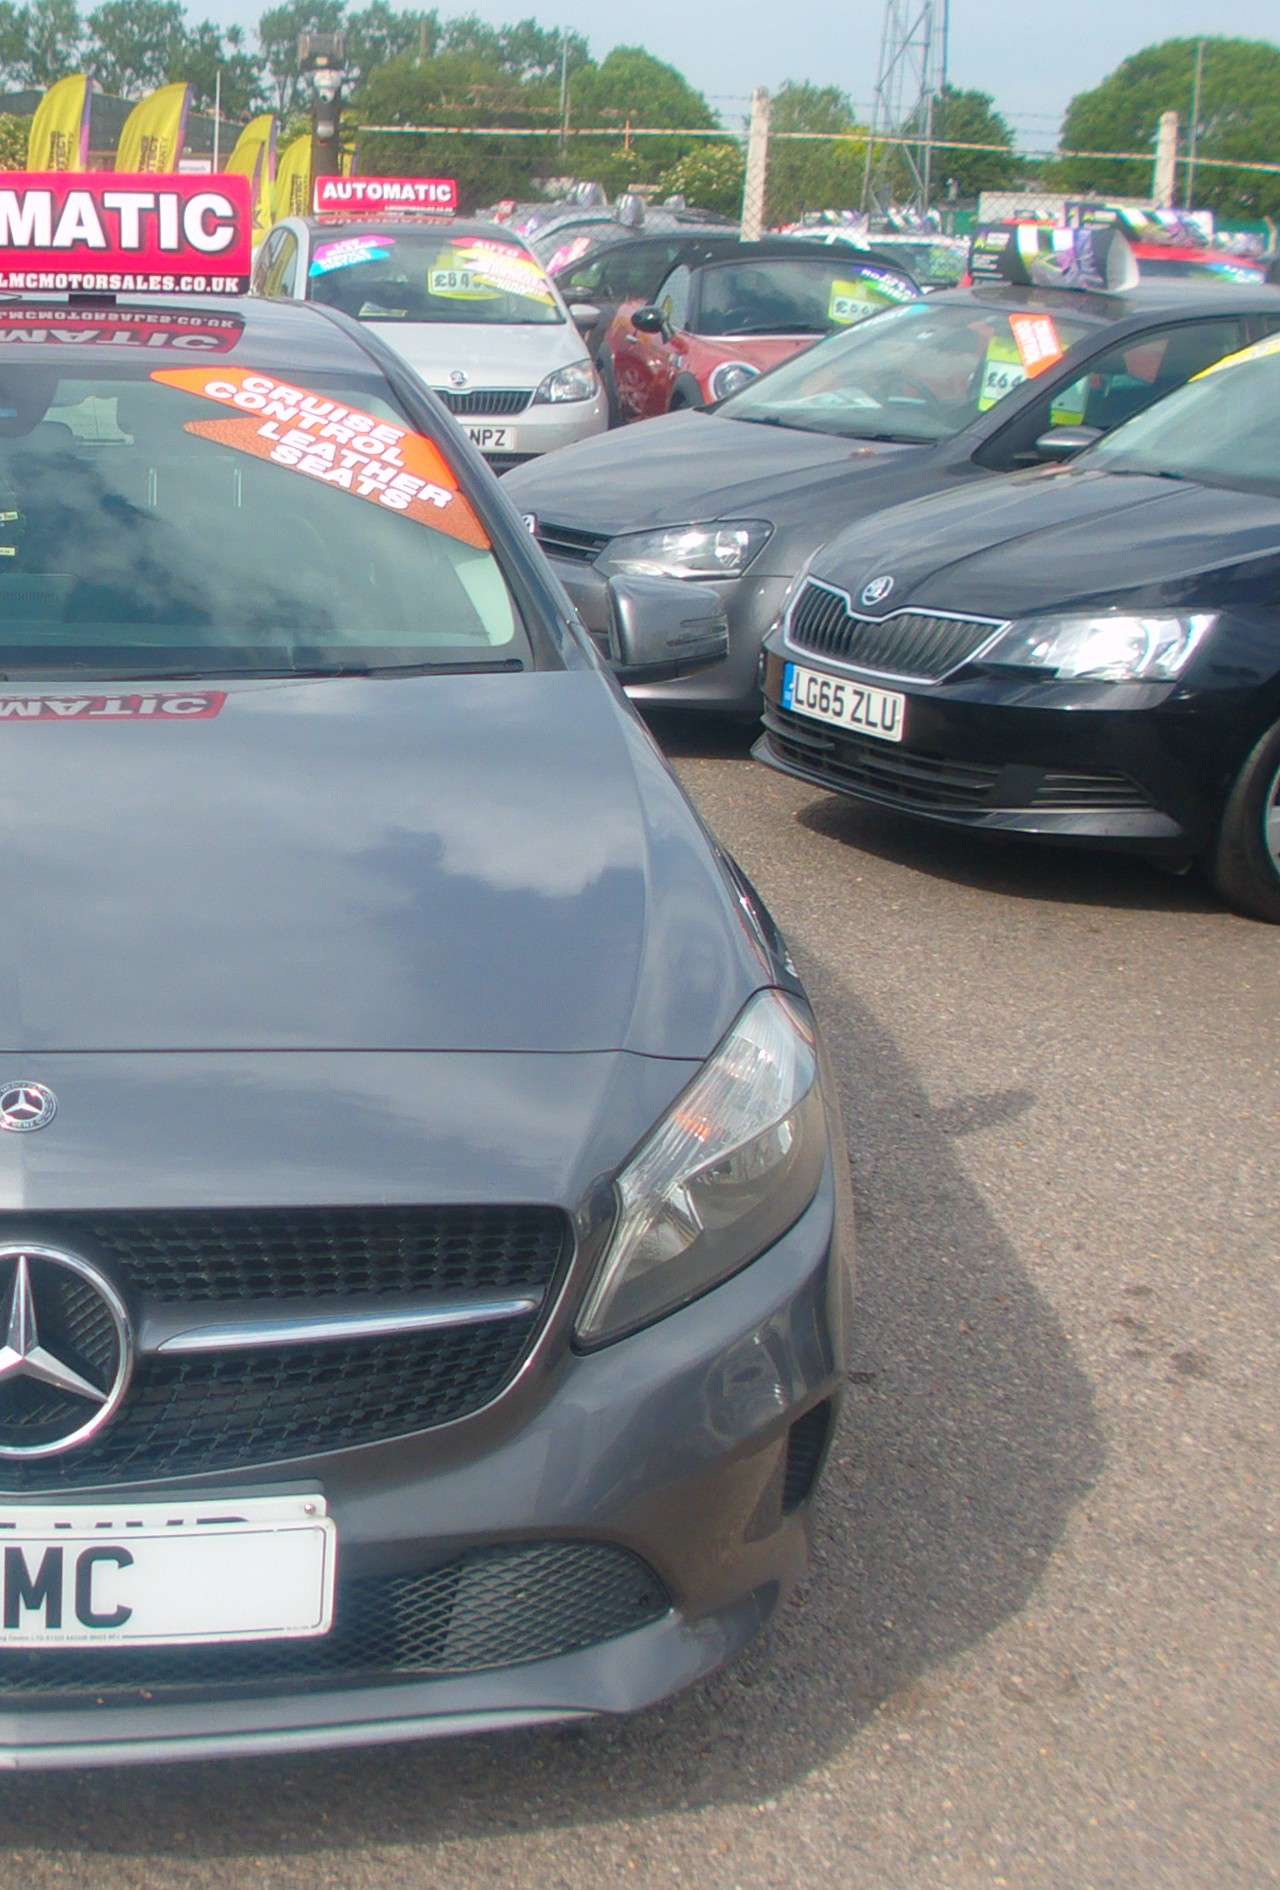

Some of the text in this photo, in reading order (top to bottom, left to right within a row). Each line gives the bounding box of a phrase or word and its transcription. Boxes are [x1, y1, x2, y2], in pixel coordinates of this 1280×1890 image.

[323, 182, 452, 201] AUTOMATIC
[204, 381, 405, 468] CONTROL
[242, 377, 405, 445] CRUISE
[470, 429, 506, 446] NPZ
[256, 420, 455, 508] LEATHER
[269, 444, 414, 510] SEATS
[794, 671, 897, 731] LG65 ZLU
